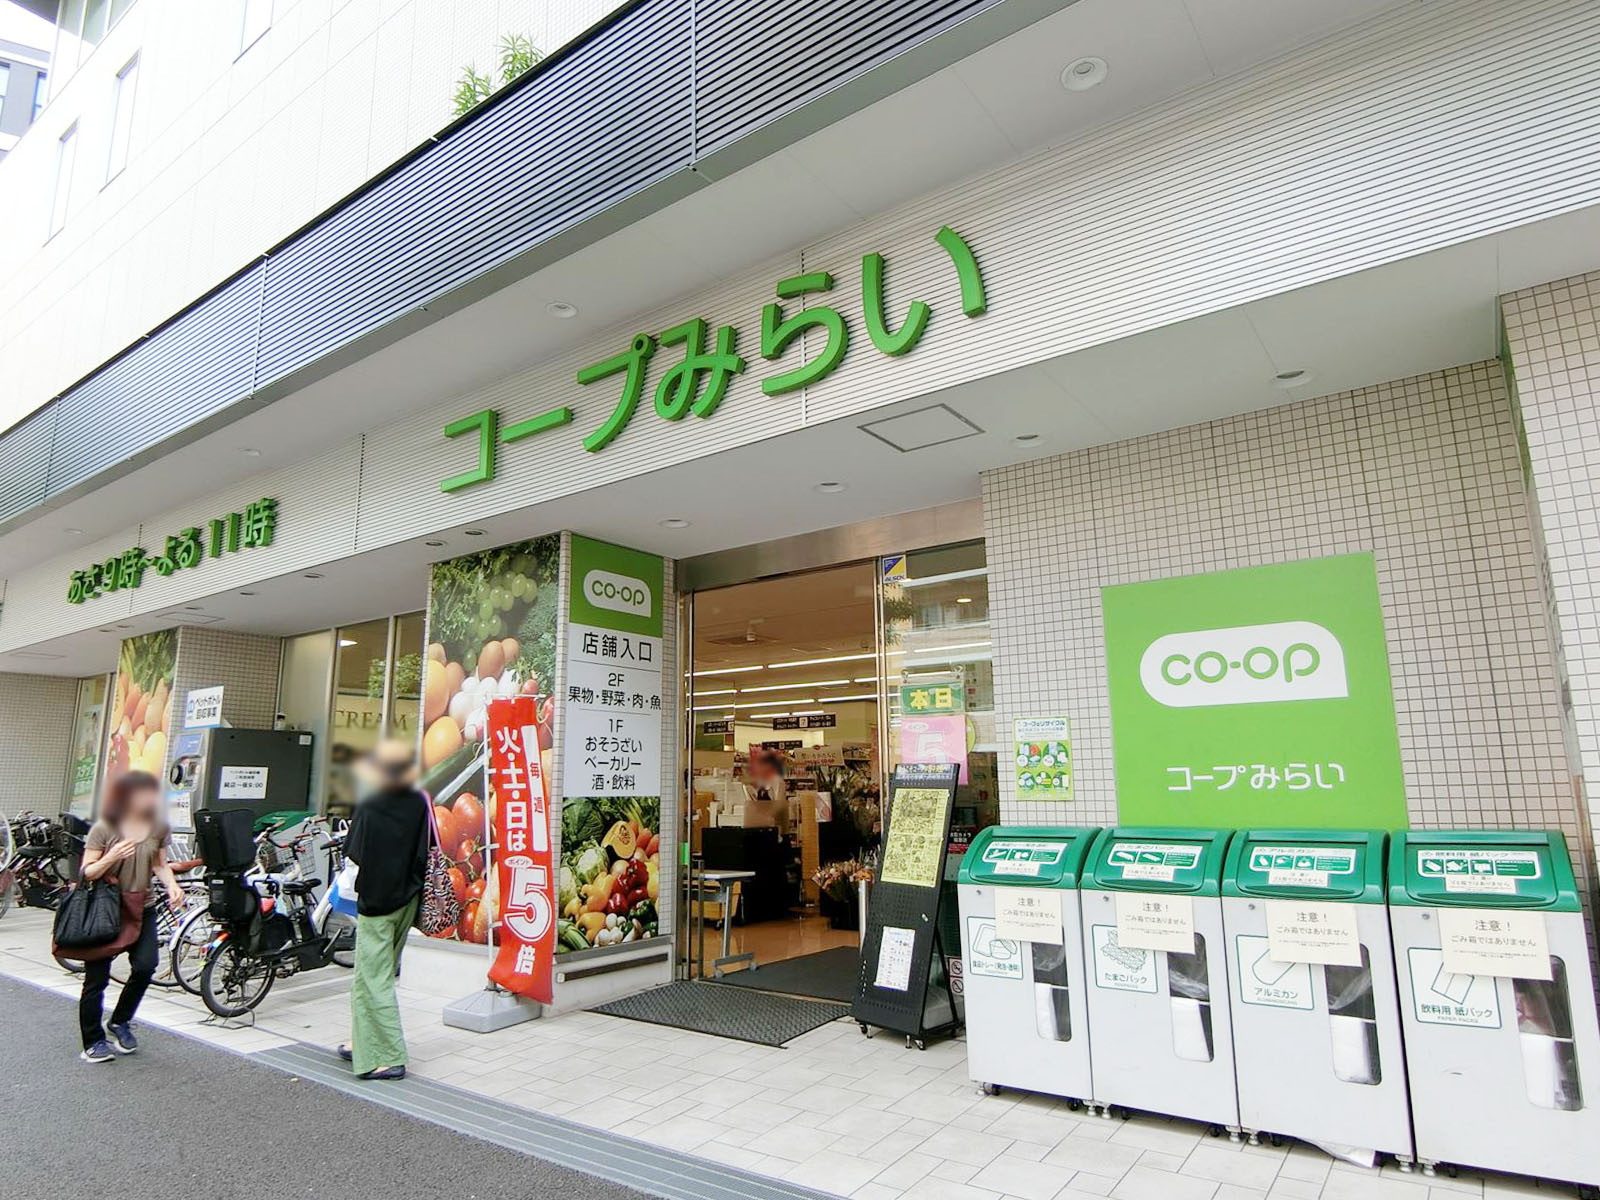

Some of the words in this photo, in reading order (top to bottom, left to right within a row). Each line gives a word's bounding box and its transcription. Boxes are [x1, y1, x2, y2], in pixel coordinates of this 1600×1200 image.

[440, 226, 988, 493] コープみらい
[582, 631, 653, 663] 店舗入口
[607, 672, 625, 687] 2F
[568, 686, 662, 710] 果物・野菜・肉・魚
[910, 687, 953, 710] 本日
[608, 719, 624, 733] 1F
[585, 736, 642, 753] おそうざい
[584, 755, 641, 772] ベーカリー
[591, 773, 636, 790] 酒・飲料
[1166, 762, 1345, 791] コープみらい
[496, 725, 528, 852] 火・土・日は
[507, 858, 530, 868] ポイント
[504, 867, 551, 942] 5
[514, 943, 536, 975] 倍
[1254, 987, 1298, 999] アルミカン
[1421, 1003, 1451, 1016] 飲料用
[1454, 1006, 1493, 1018] 紙パック
